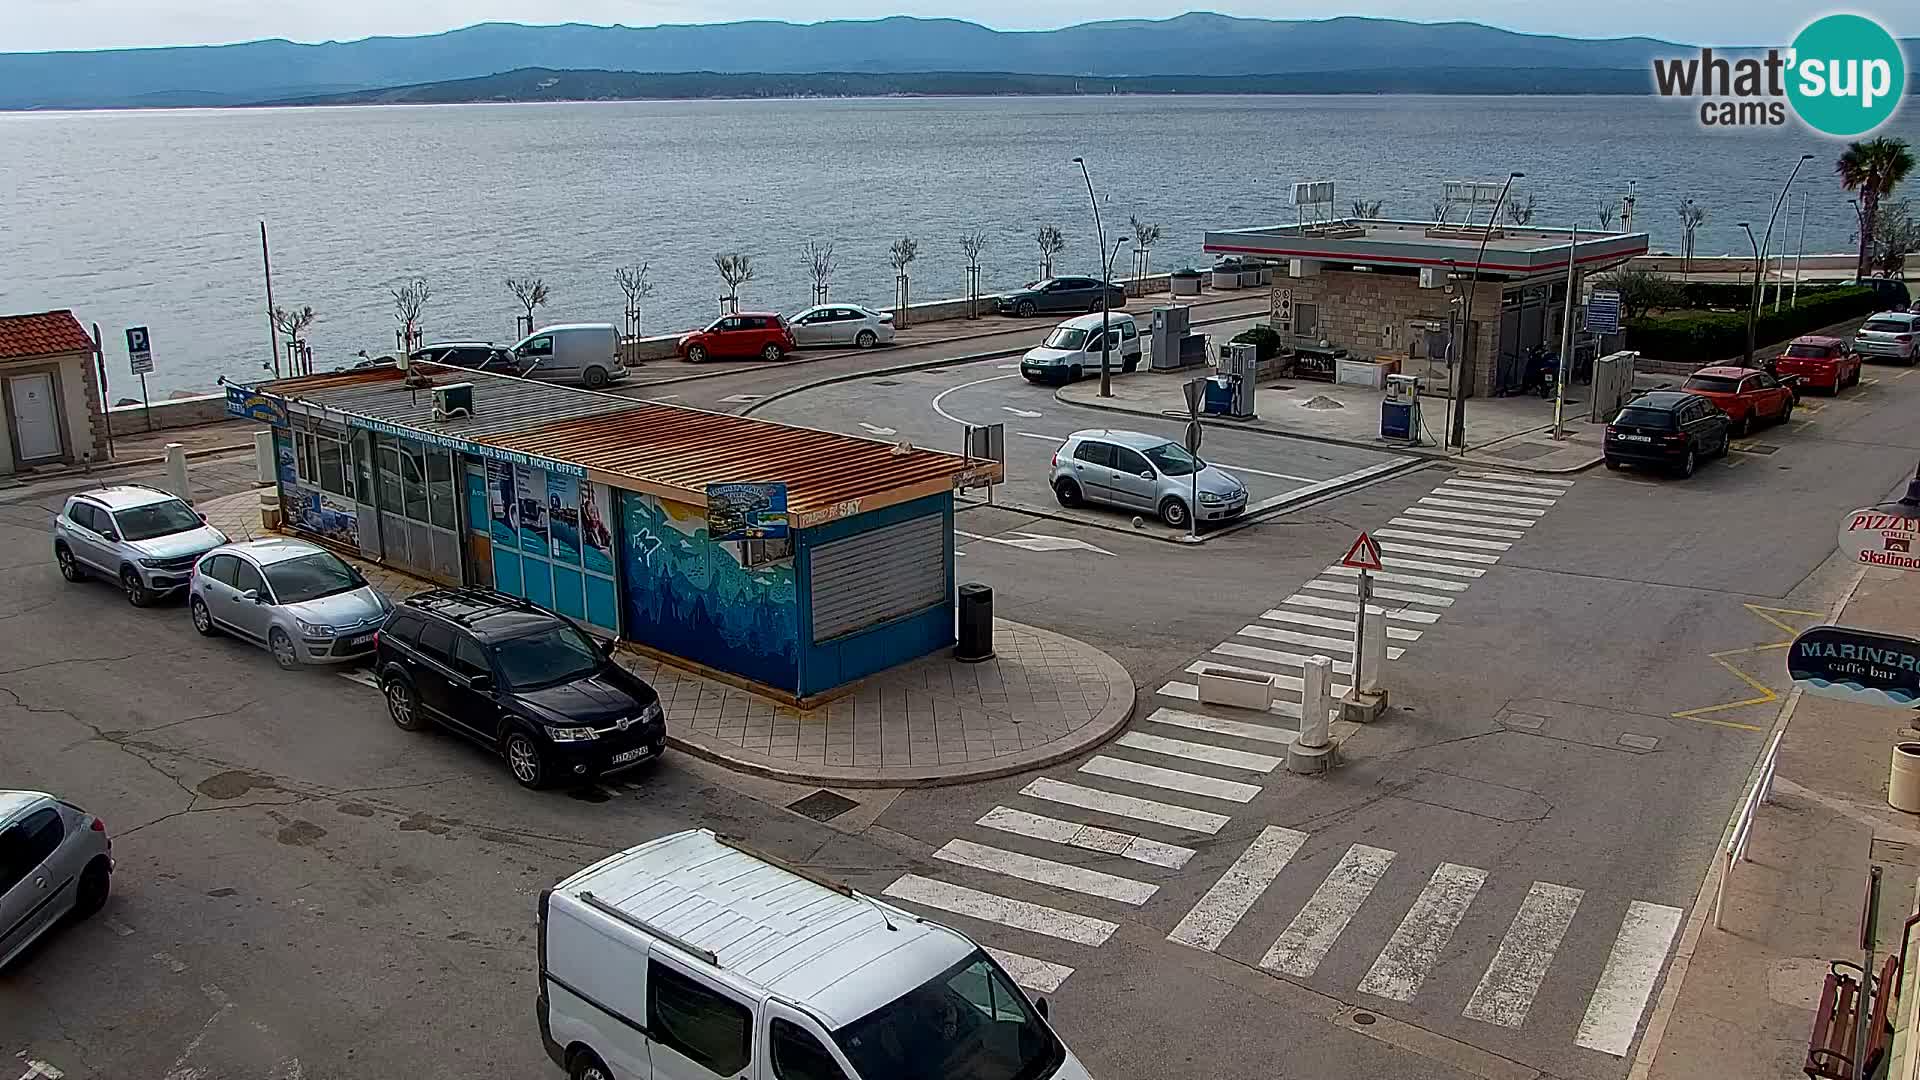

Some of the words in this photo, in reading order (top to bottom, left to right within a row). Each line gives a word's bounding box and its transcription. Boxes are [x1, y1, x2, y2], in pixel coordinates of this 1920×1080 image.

[131, 331, 144, 349] P
[437, 437, 470, 451] POSTAJA
[479, 445, 494, 457] BUS
[495, 449, 527, 465] STATION
[528, 457, 554, 471] TICKET
[556, 463, 583, 476] OFFICE
[1881, 530, 1916, 541] GRILL
[1870, 665, 1897, 680] bar
